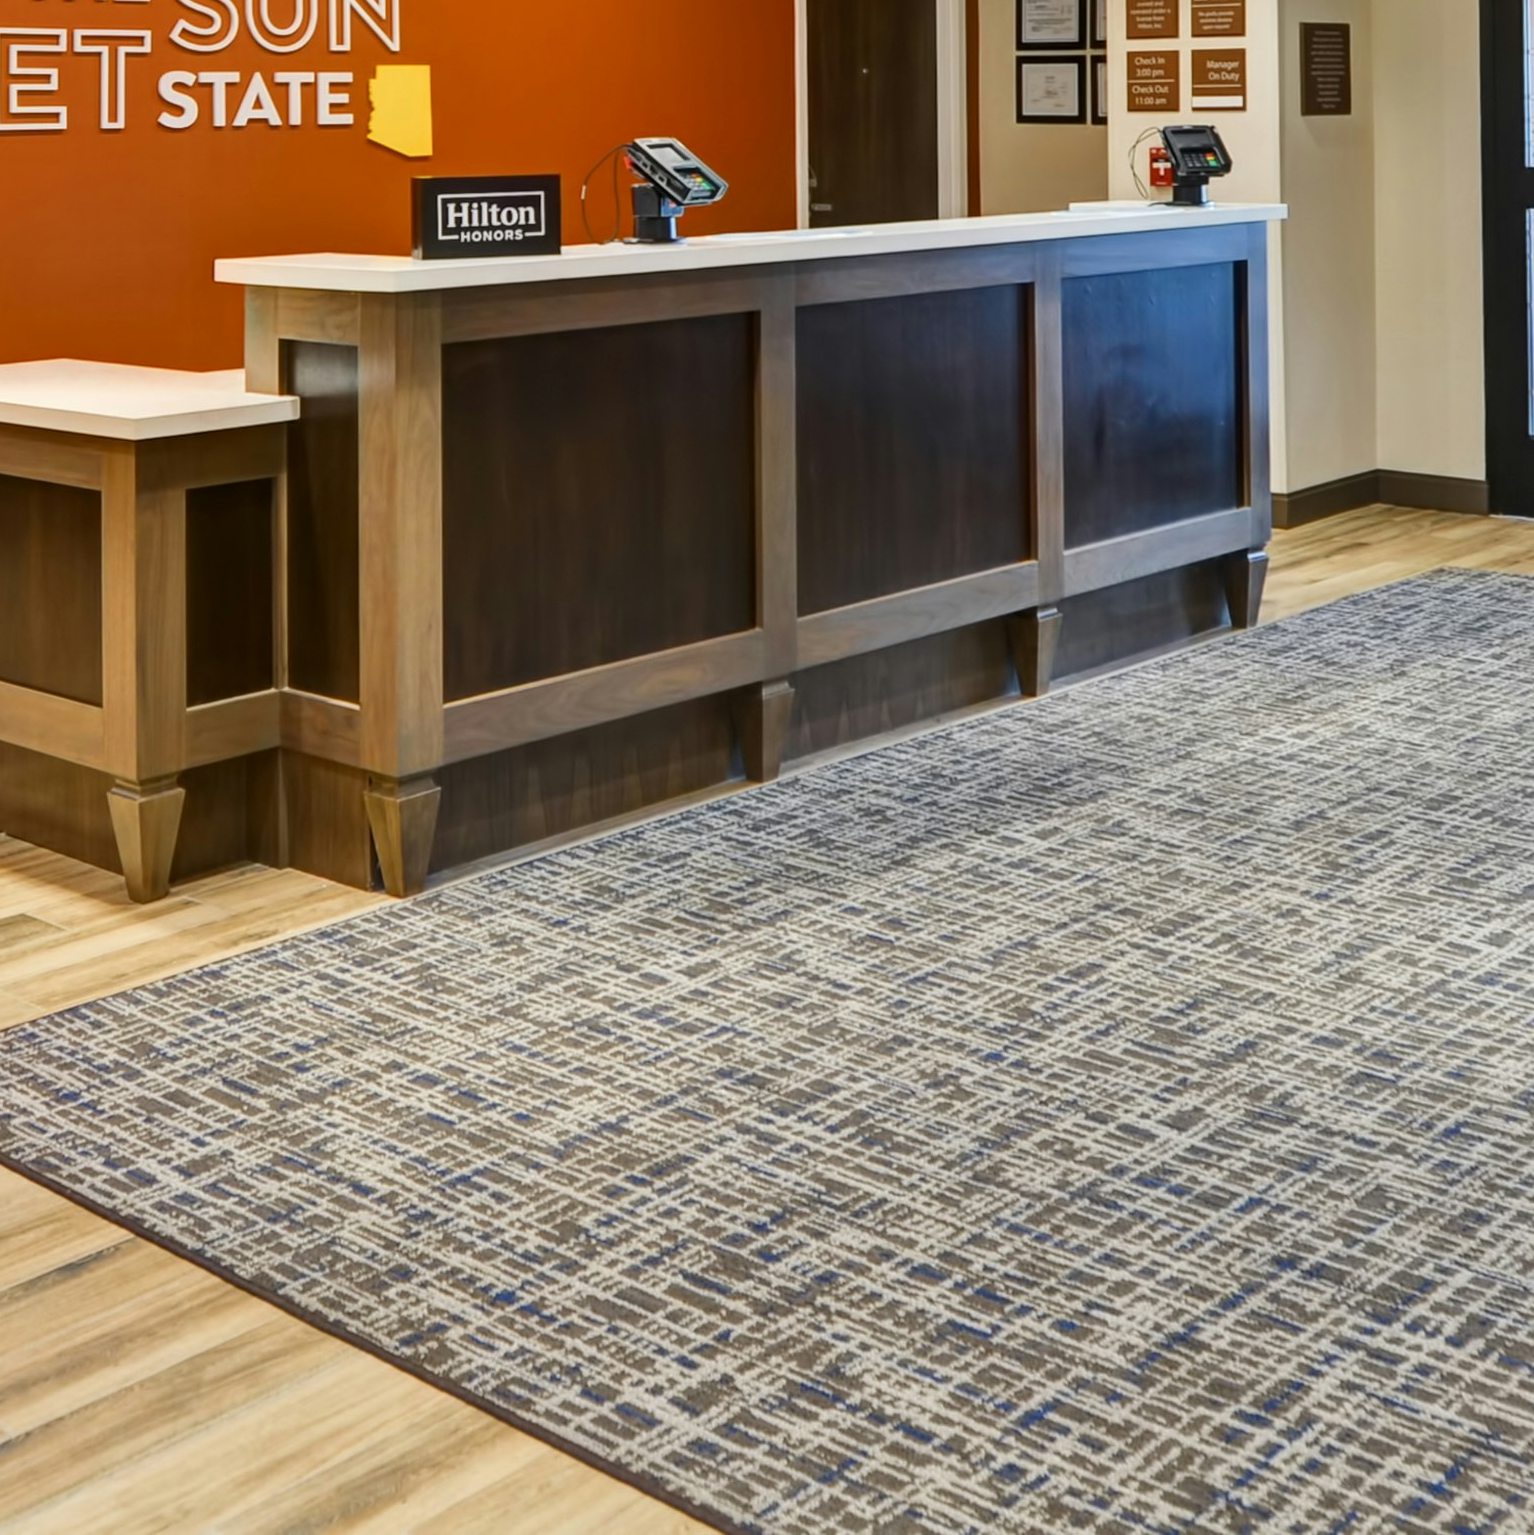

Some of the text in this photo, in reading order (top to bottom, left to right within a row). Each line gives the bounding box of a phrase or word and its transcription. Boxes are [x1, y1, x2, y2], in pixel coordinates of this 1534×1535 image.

[1134, 56, 1166, 65] Check In
[1206, 60, 1239, 70] Manager
[1208, 71, 1240, 82] On Duty
[1132, 85, 1169, 94] Check Out
[157, 70, 354, 129] STATE
[446, 201, 536, 228] Hilton
[460, 229, 524, 243] HONORS
